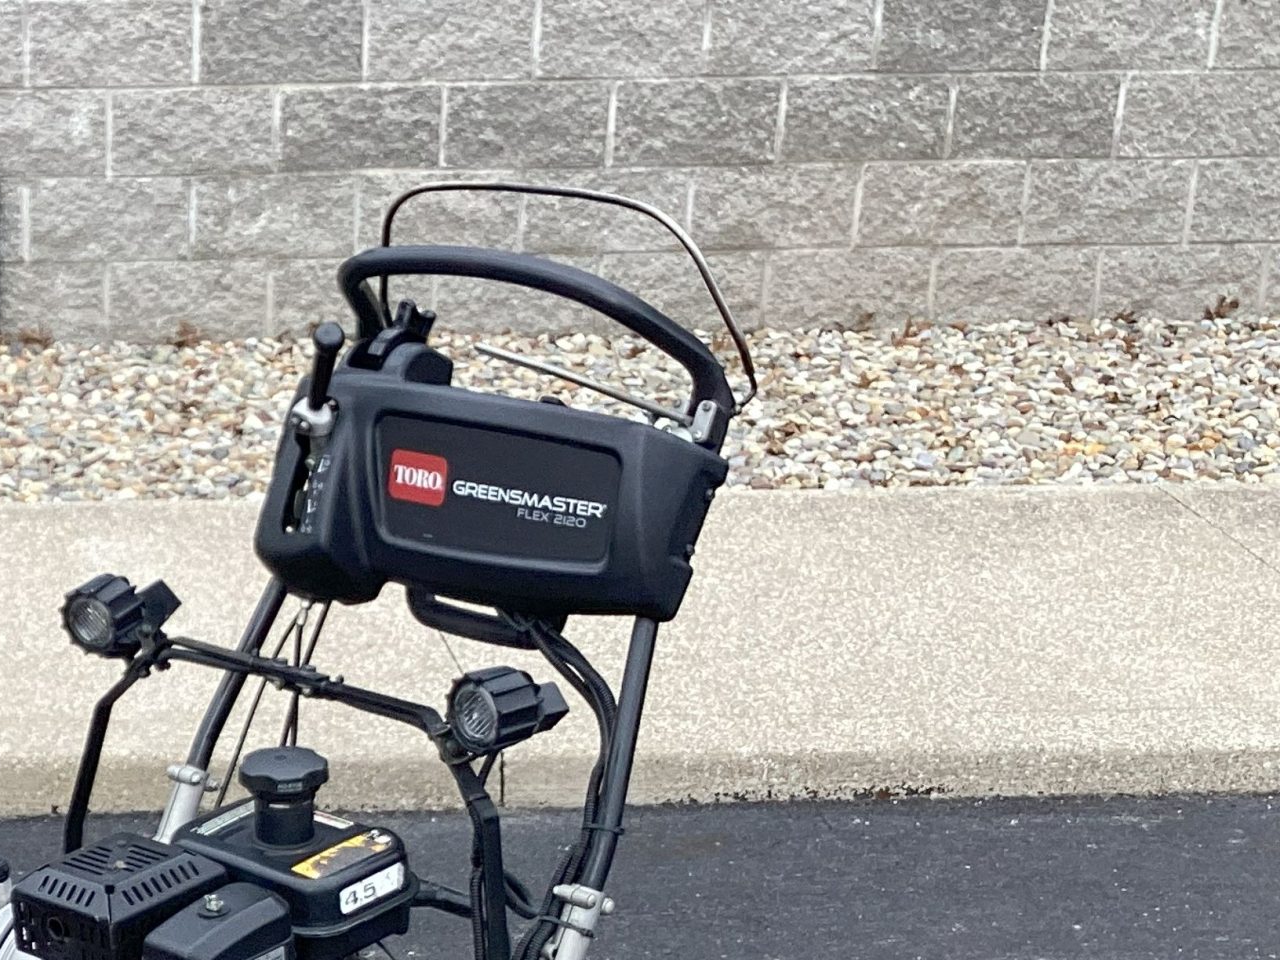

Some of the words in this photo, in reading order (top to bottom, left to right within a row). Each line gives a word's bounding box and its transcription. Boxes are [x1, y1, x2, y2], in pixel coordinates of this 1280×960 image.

[393, 464, 443, 491] TORO
[452, 480, 606, 518] GREENSMASTER
[516, 507, 550, 523] FLEX
[553, 513, 587, 528] 2120
[345, 882, 377, 906] 4.5
